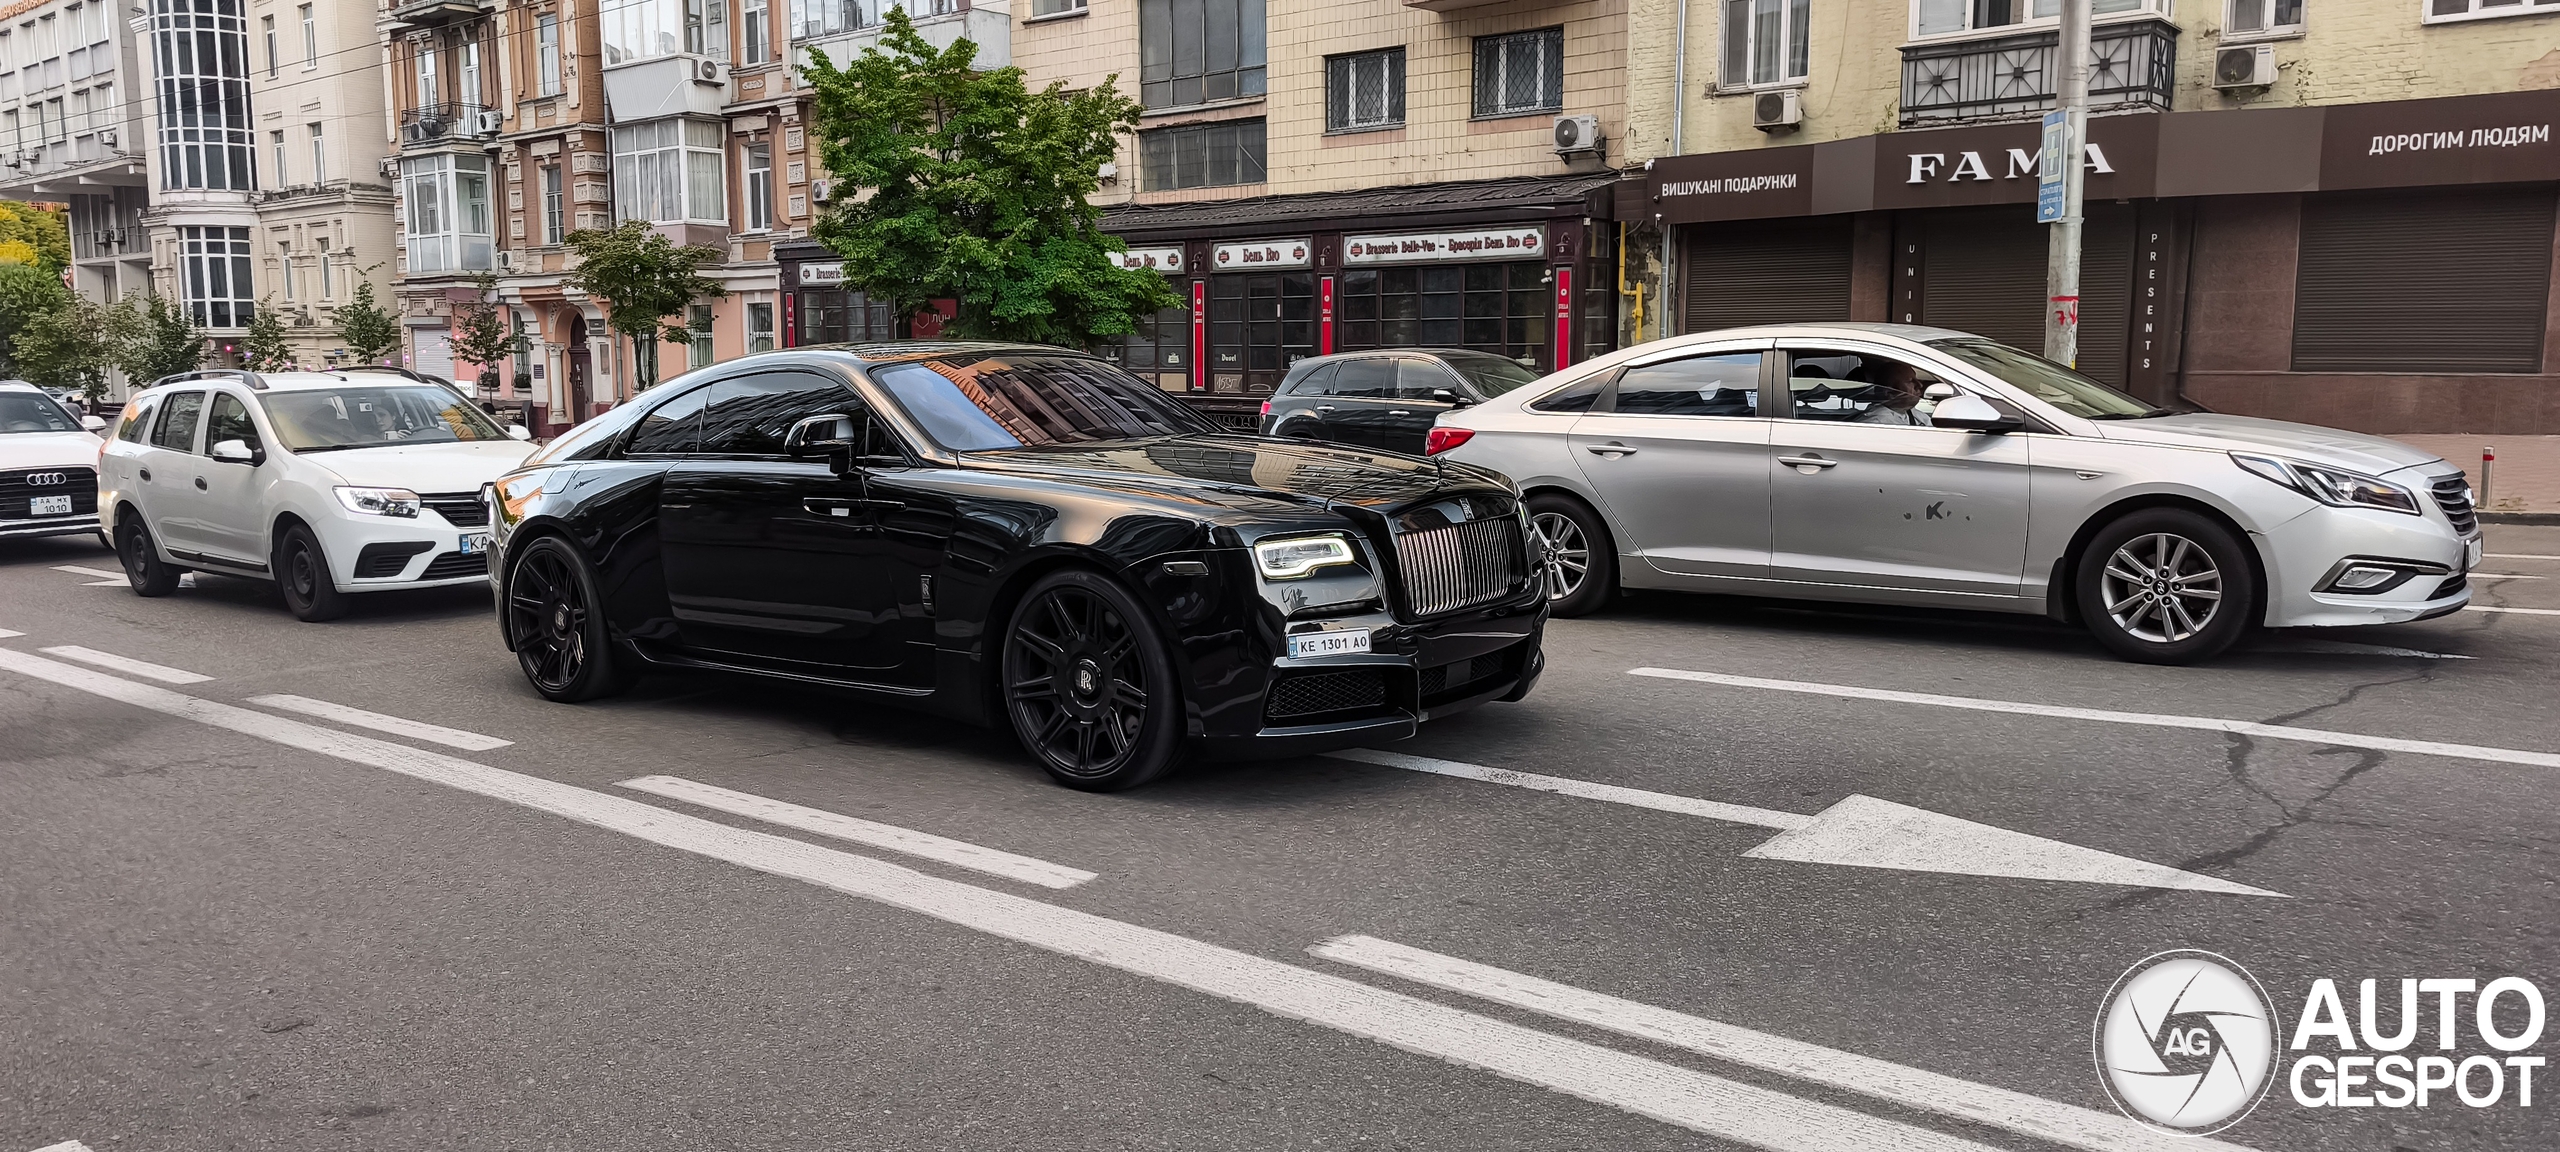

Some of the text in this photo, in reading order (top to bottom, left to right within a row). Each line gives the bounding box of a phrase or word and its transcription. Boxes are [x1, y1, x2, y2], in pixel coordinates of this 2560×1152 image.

[2369, 124, 2550, 156] ДОРОГИМ ЛЮДЯМ
[1662, 174, 1797, 197] ВИШУКАНІ ПОДАРУНКИ
[1365, 241, 1399, 255] Brasserie
[1401, 239, 1436, 253] Belle-Vue
[1484, 236, 1505, 250] Бель
[1506, 235, 1520, 248] Вю
[1123, 254, 1142, 268] Бель
[1242, 247, 1280, 263] Бель Вю
[2143, 233, 2158, 369] PRESENTS
[44, 504, 67, 513] 1010
[1300, 640, 1316, 653] KE
[1320, 637, 1348, 651] 1301
